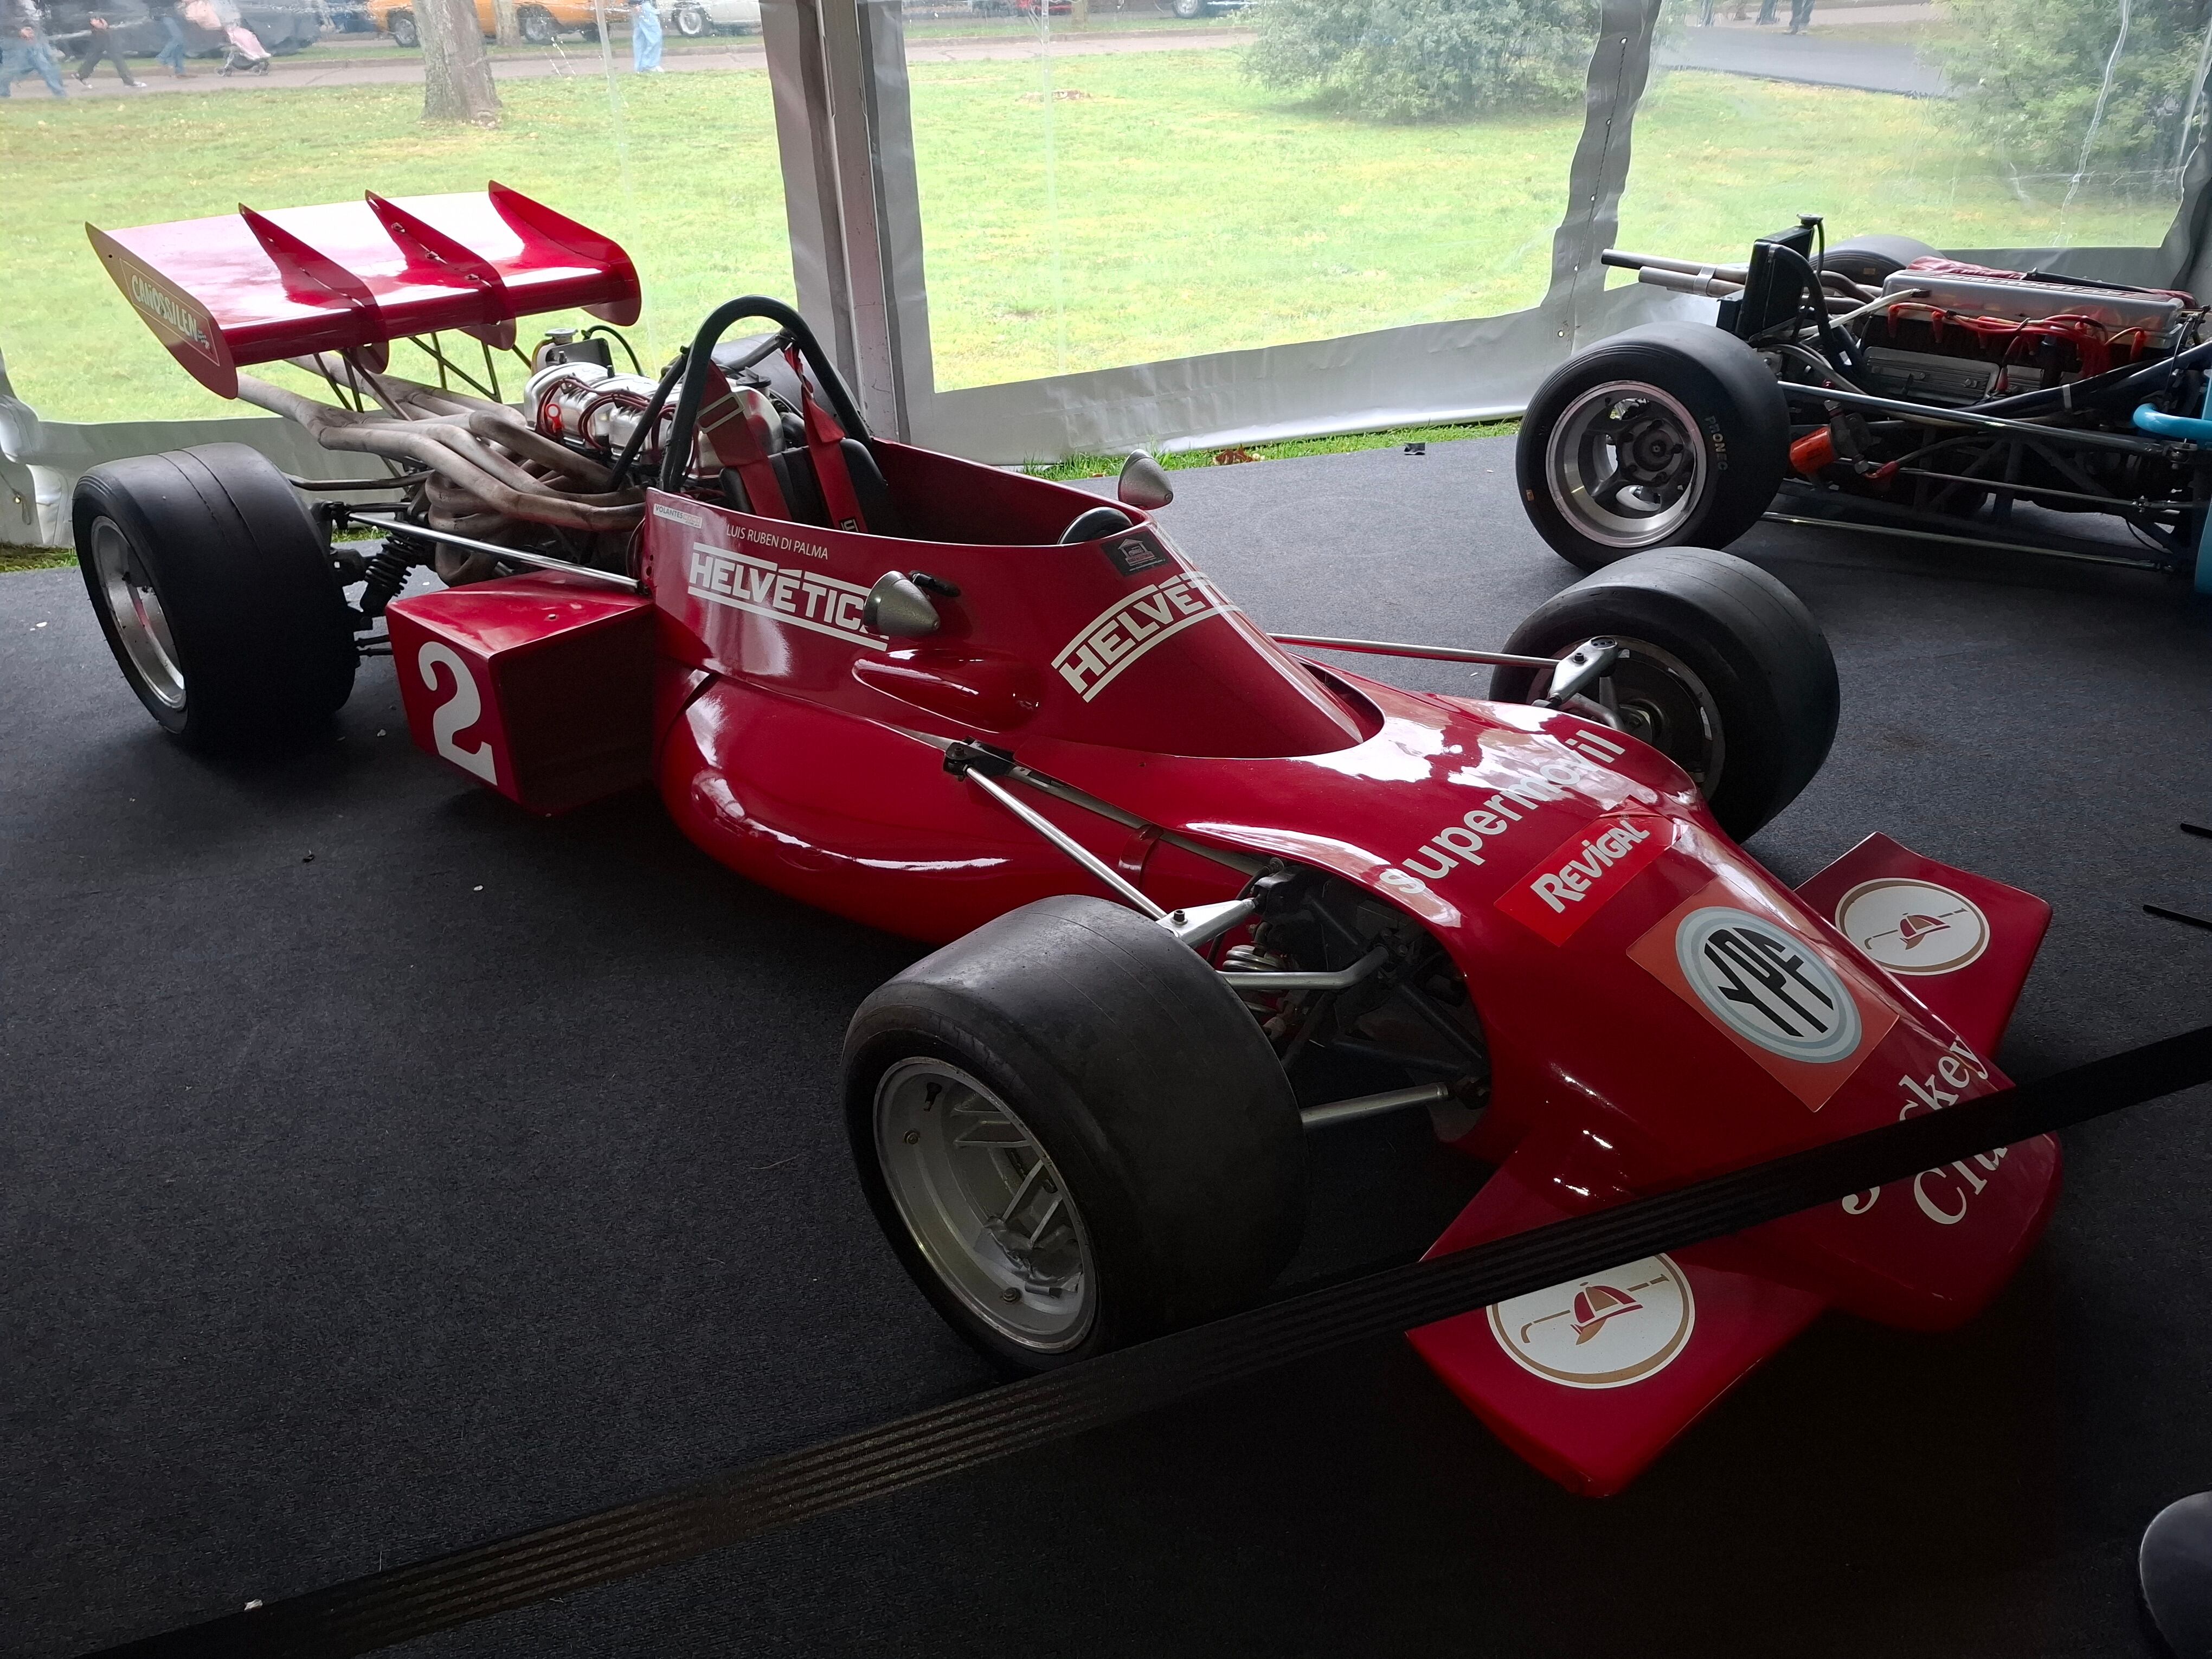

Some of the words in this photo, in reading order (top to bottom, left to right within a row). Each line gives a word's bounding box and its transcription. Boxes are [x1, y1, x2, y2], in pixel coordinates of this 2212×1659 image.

[726, 524, 746, 539] LUIS
[747, 529, 780, 548] RUBEN
[781, 537, 792, 551] DI
[793, 541, 828, 560] PALMA
[418, 641, 498, 786] 2
[1704, 927, 1834, 1037] YPF
